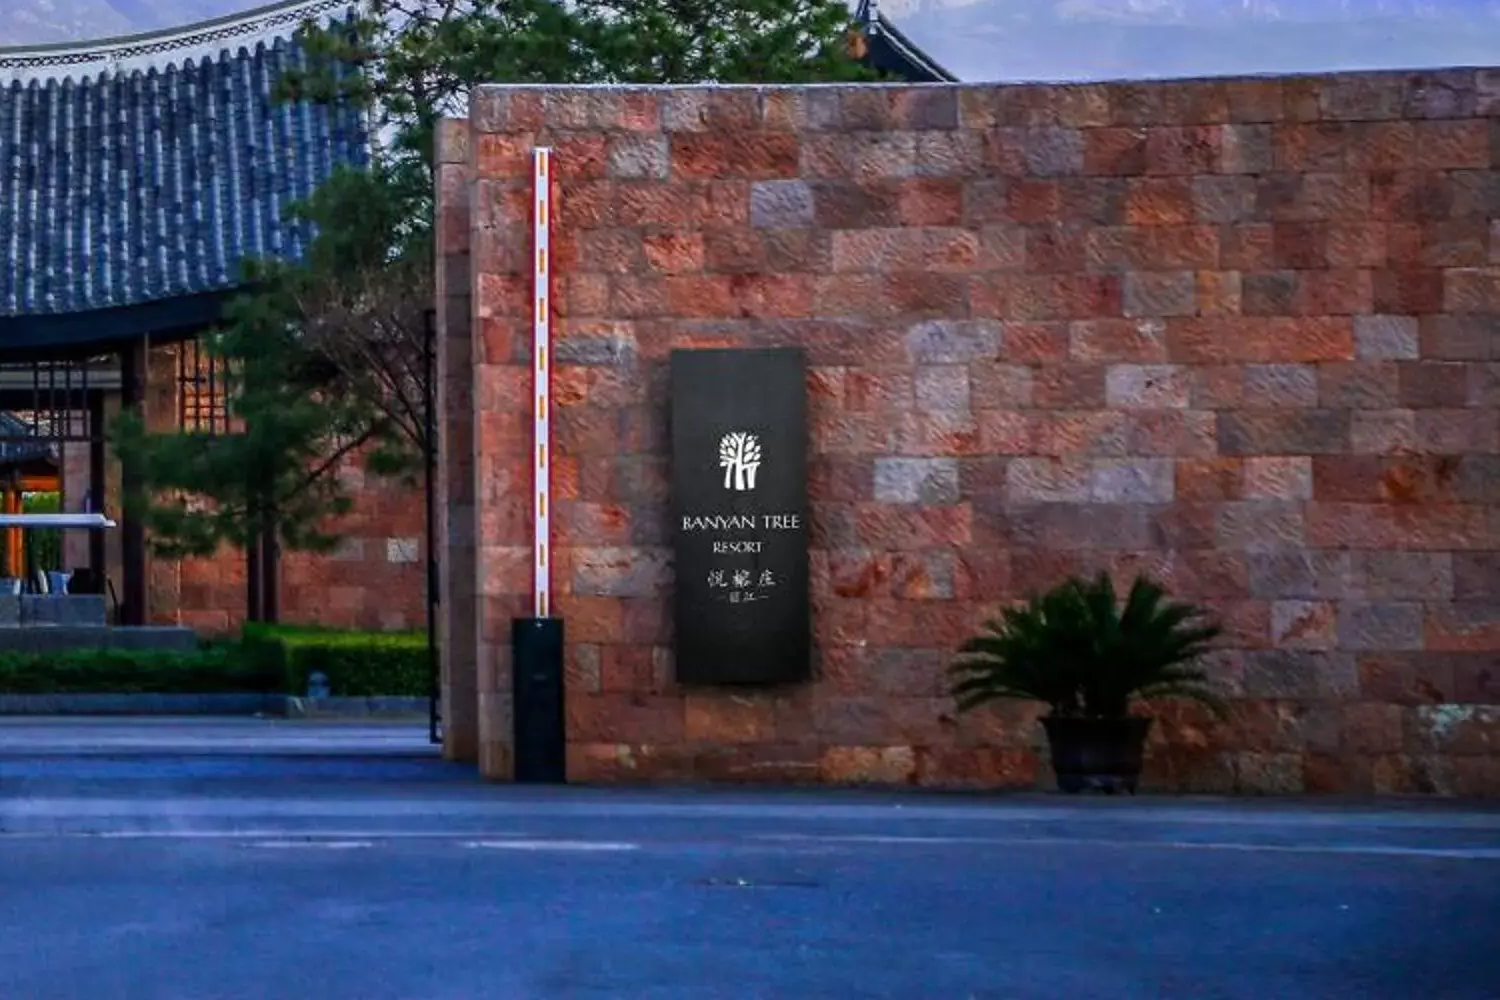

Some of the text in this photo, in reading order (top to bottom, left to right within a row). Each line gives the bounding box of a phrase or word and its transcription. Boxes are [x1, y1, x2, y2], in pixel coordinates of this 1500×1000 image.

[682, 514, 800, 530] BANYAN TREE
[713, 541, 764, 553] RESORT
